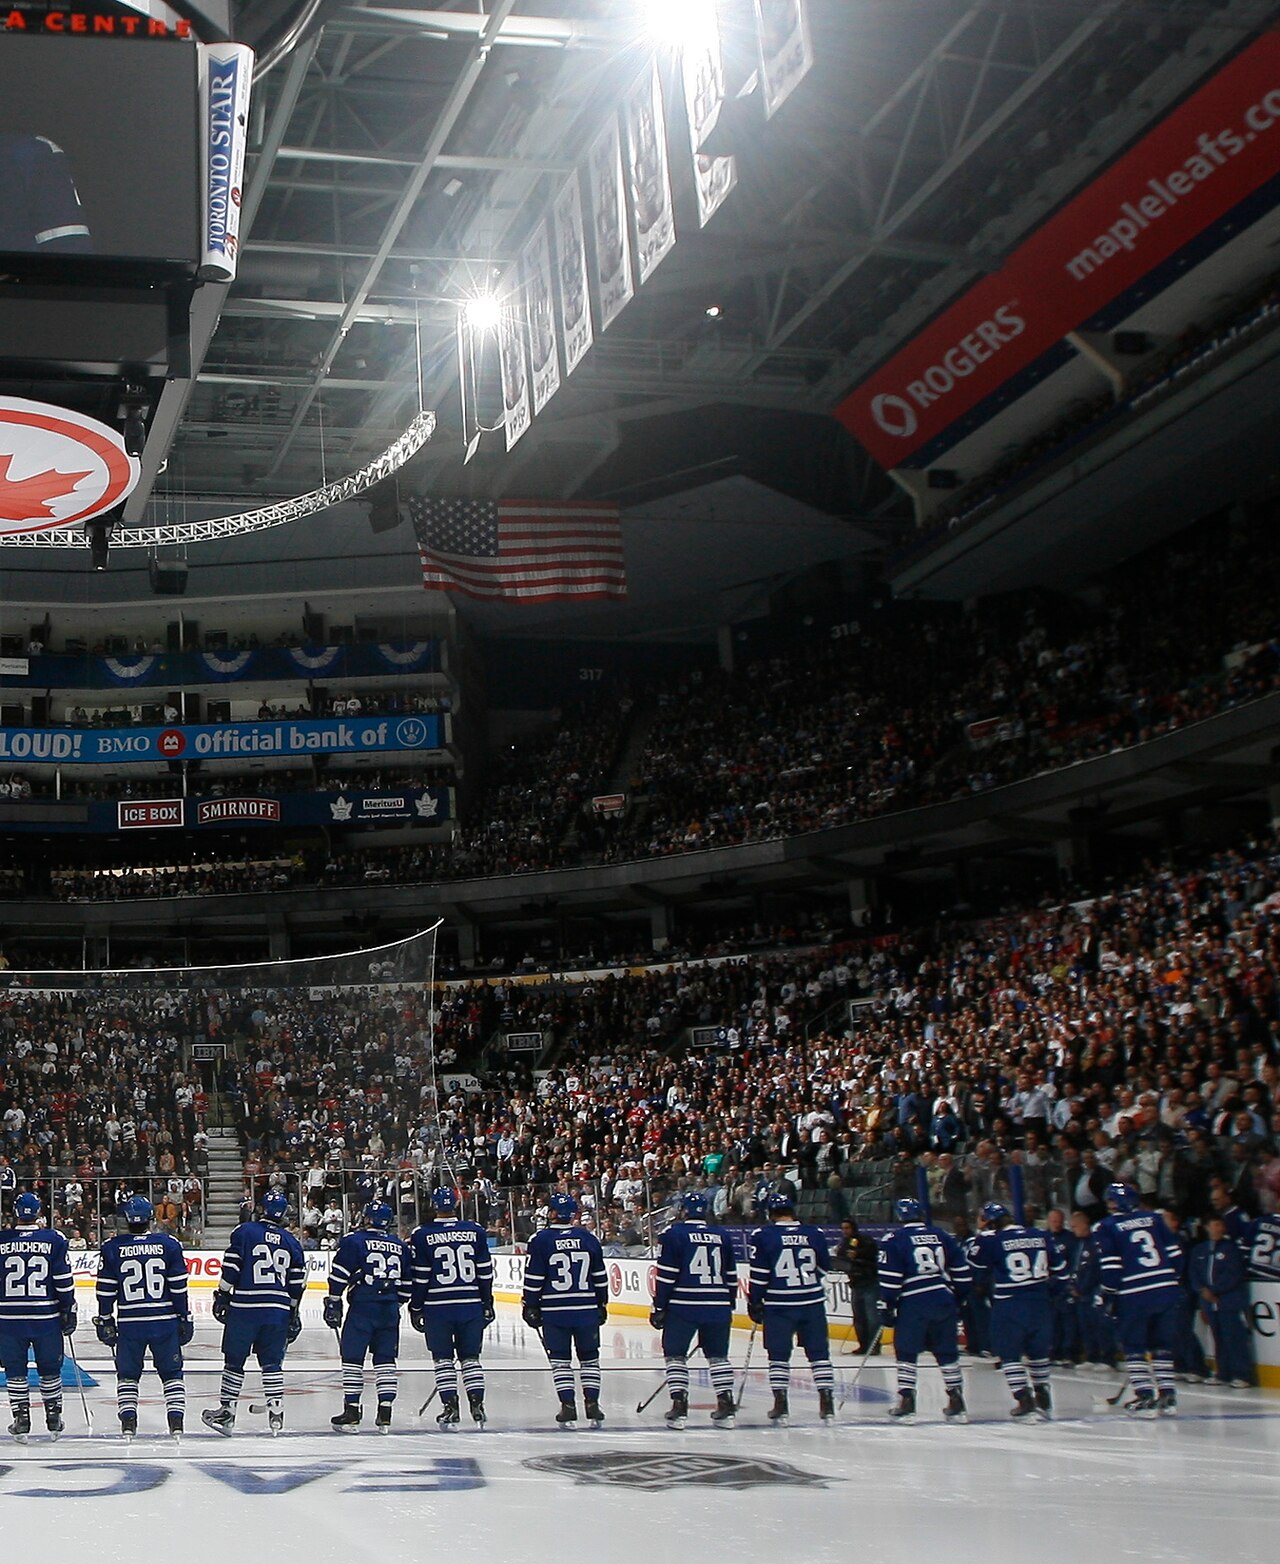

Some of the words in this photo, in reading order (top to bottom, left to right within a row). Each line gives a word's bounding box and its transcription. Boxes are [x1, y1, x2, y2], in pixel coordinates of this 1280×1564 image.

[45, 12, 193, 39] CENTRE
[210, 73, 234, 148] STAR
[209, 152, 229, 246] TORONTO
[906, 304, 1026, 408] ROGERS
[578, 667, 604, 681] 317
[96, 736, 151, 754] BMO
[194, 727, 282, 754] Official
[289, 724, 356, 750] bank
[360, 722, 389, 746] of
[124, 807, 147, 822] ICE
[150, 806, 179, 820] BOX
[201, 800, 276, 820] SMIRNOFF
[196, 1046, 224, 1059] IBM
[511, 1035, 539, 1048] IBM
[0, 1241, 53, 1255] BEAUCHEMIN
[265, 1231, 281, 1245] ORR
[554, 1239, 581, 1251] BRENT
[1129, 1229, 1161, 1268] 3
[74, 1253, 97, 1270] the
[251, 1243, 292, 1287] 28
[433, 1244, 477, 1285] 36
[548, 1251, 591, 1292] 37
[689, 1245, 724, 1285] 41
[774, 1247, 818, 1287] 42
[912, 1245, 947, 1275] 81
[1005, 1249, 1049, 1282] 84
[4, 1255, 50, 1298] 22
[120, 1257, 167, 1301] 26
[624, 1270, 641, 1292] LG
[1251, 1301, 1280, 1337] e
[598, 1457, 734, 1482] NHL
